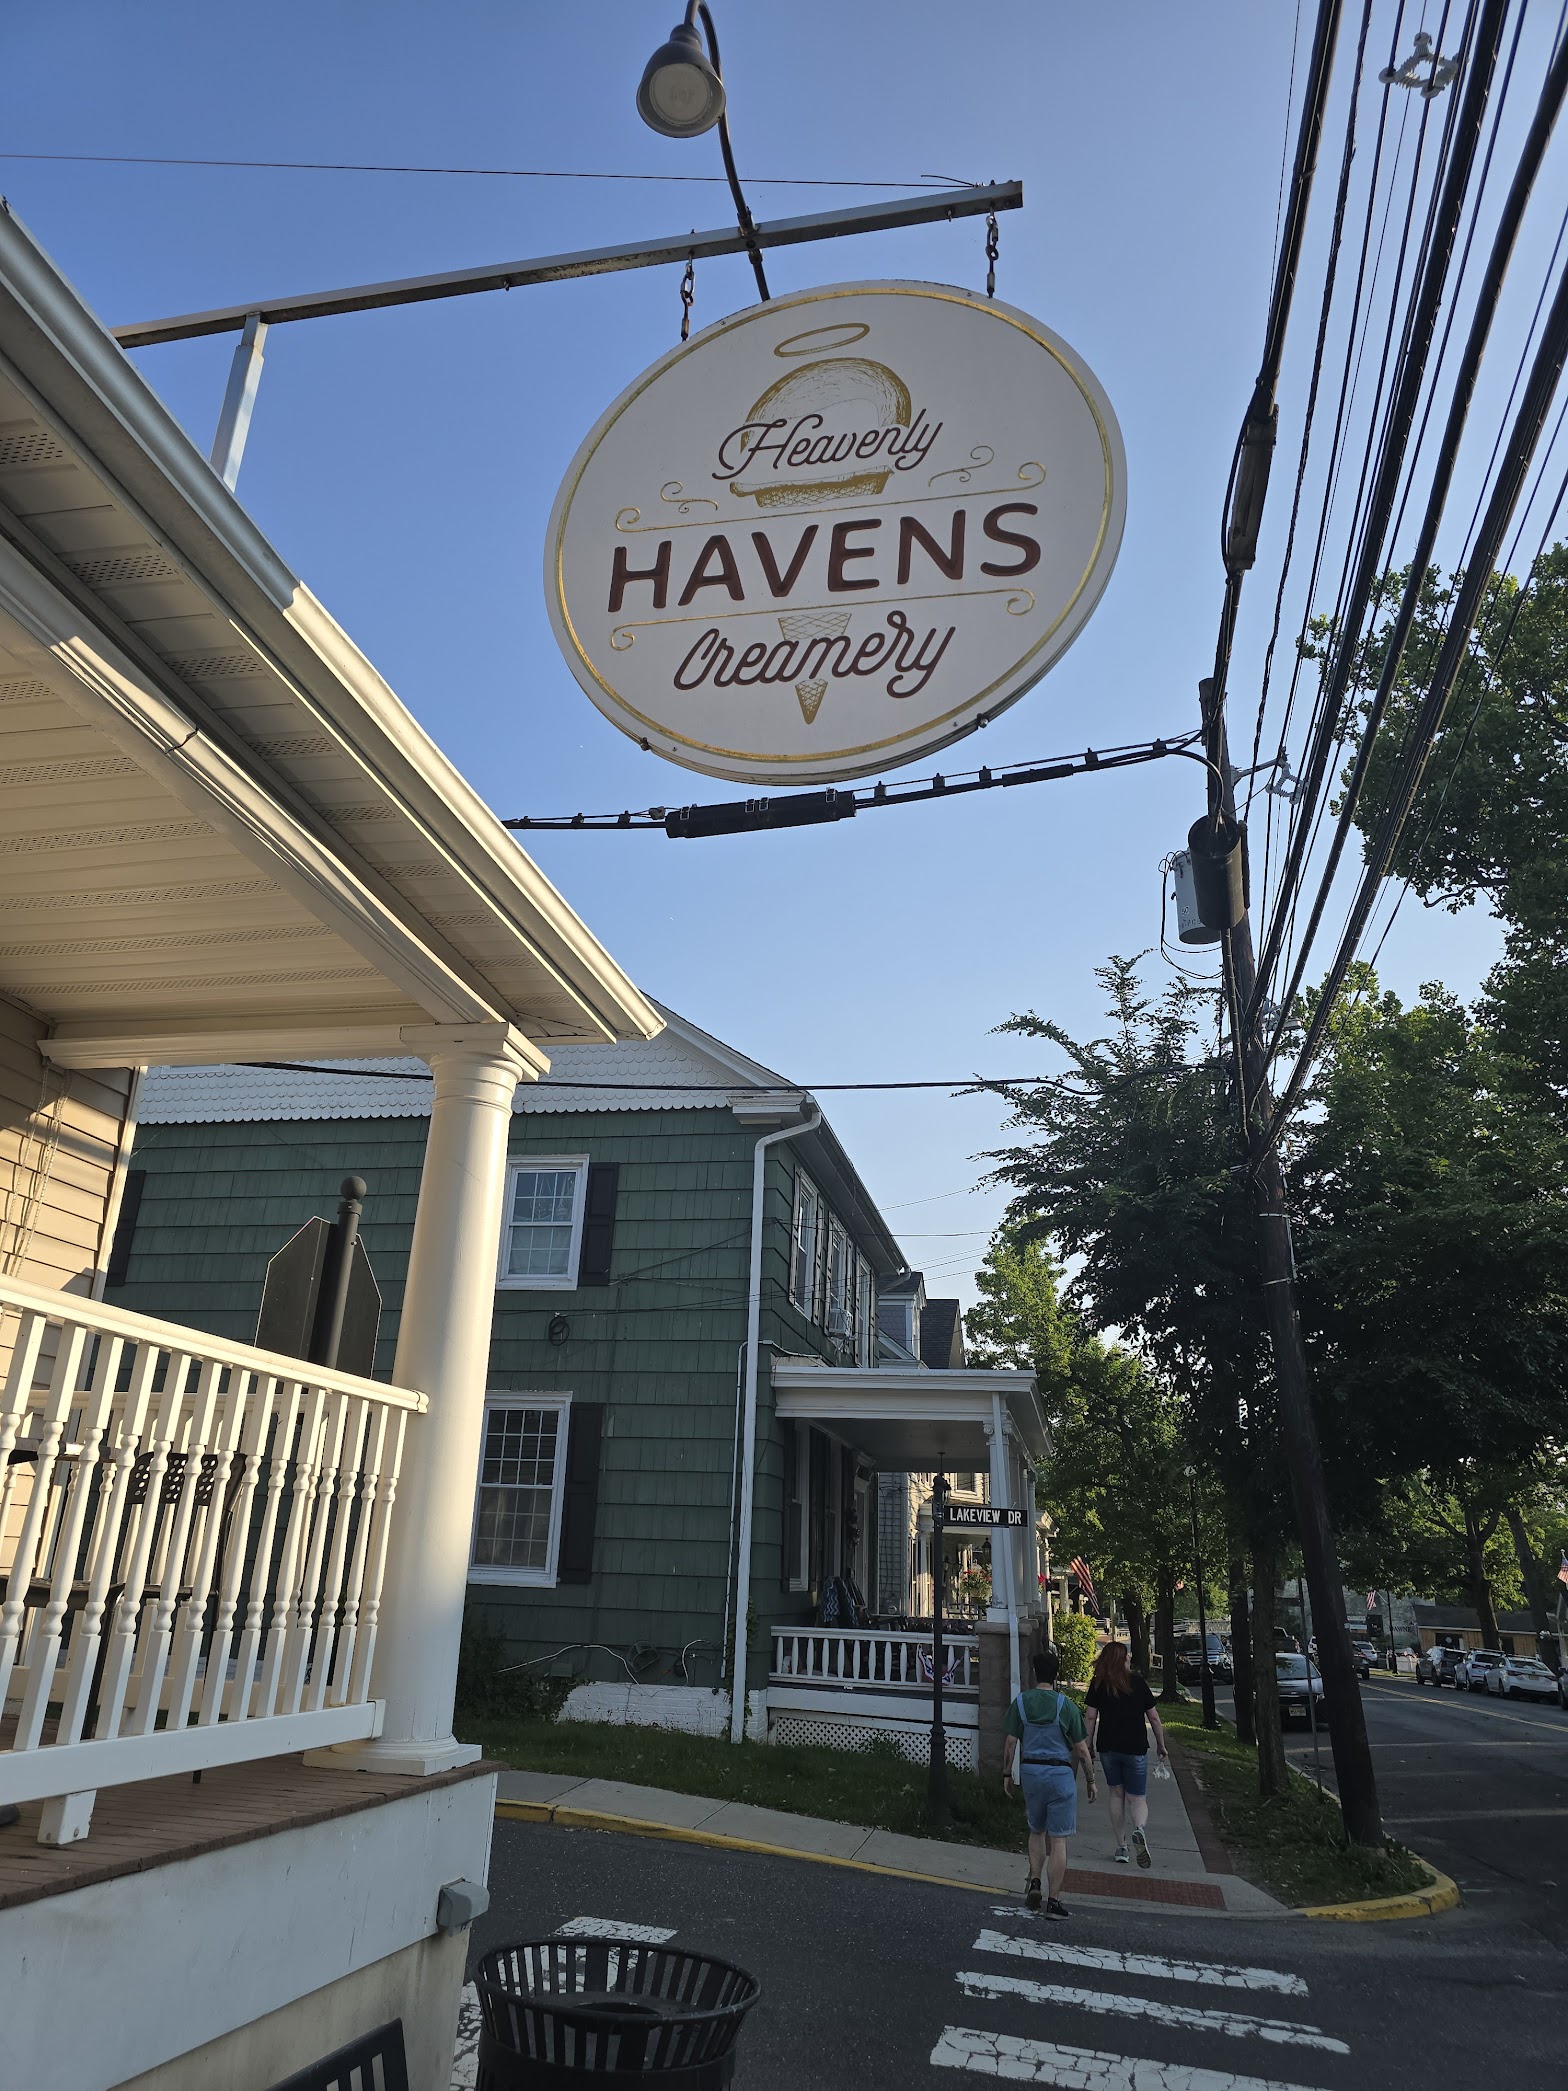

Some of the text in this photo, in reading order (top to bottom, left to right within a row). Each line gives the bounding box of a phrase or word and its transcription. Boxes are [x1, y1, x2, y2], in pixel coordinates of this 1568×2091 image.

[711, 408, 943, 480] Heavenly
[608, 502, 1041, 612] HAVENS
[673, 610, 955, 699] Creamery
[949, 1507, 1021, 1524] LAKEVIEW DR
